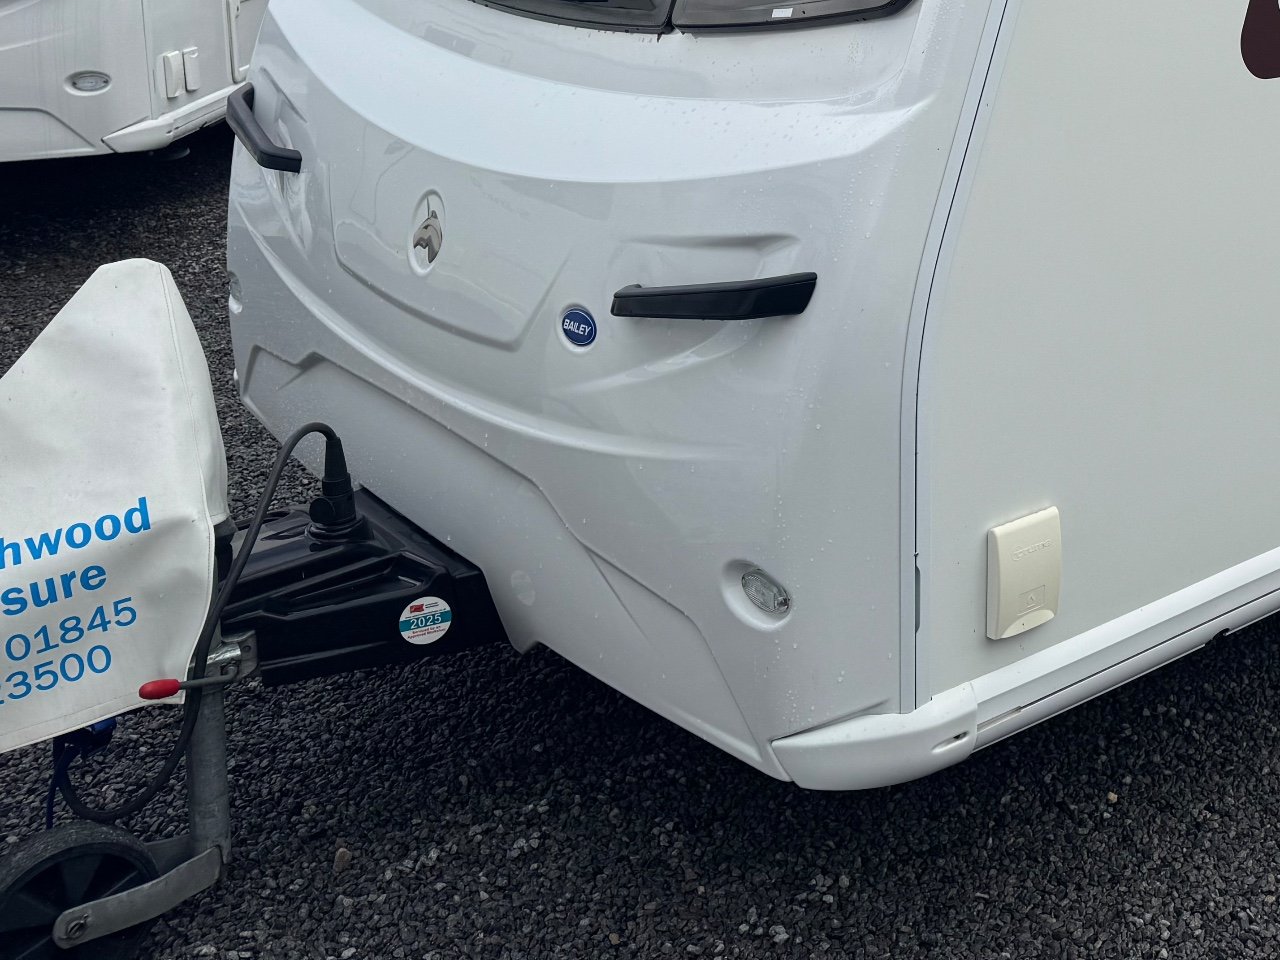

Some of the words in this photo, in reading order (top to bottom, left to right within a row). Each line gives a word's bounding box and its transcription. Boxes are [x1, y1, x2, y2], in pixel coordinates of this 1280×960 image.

[563, 318, 592, 336] BAILEY
[5, 596, 137, 662] 01845
[410, 613, 442, 629] 2025
[0, 644, 112, 704] 3500
